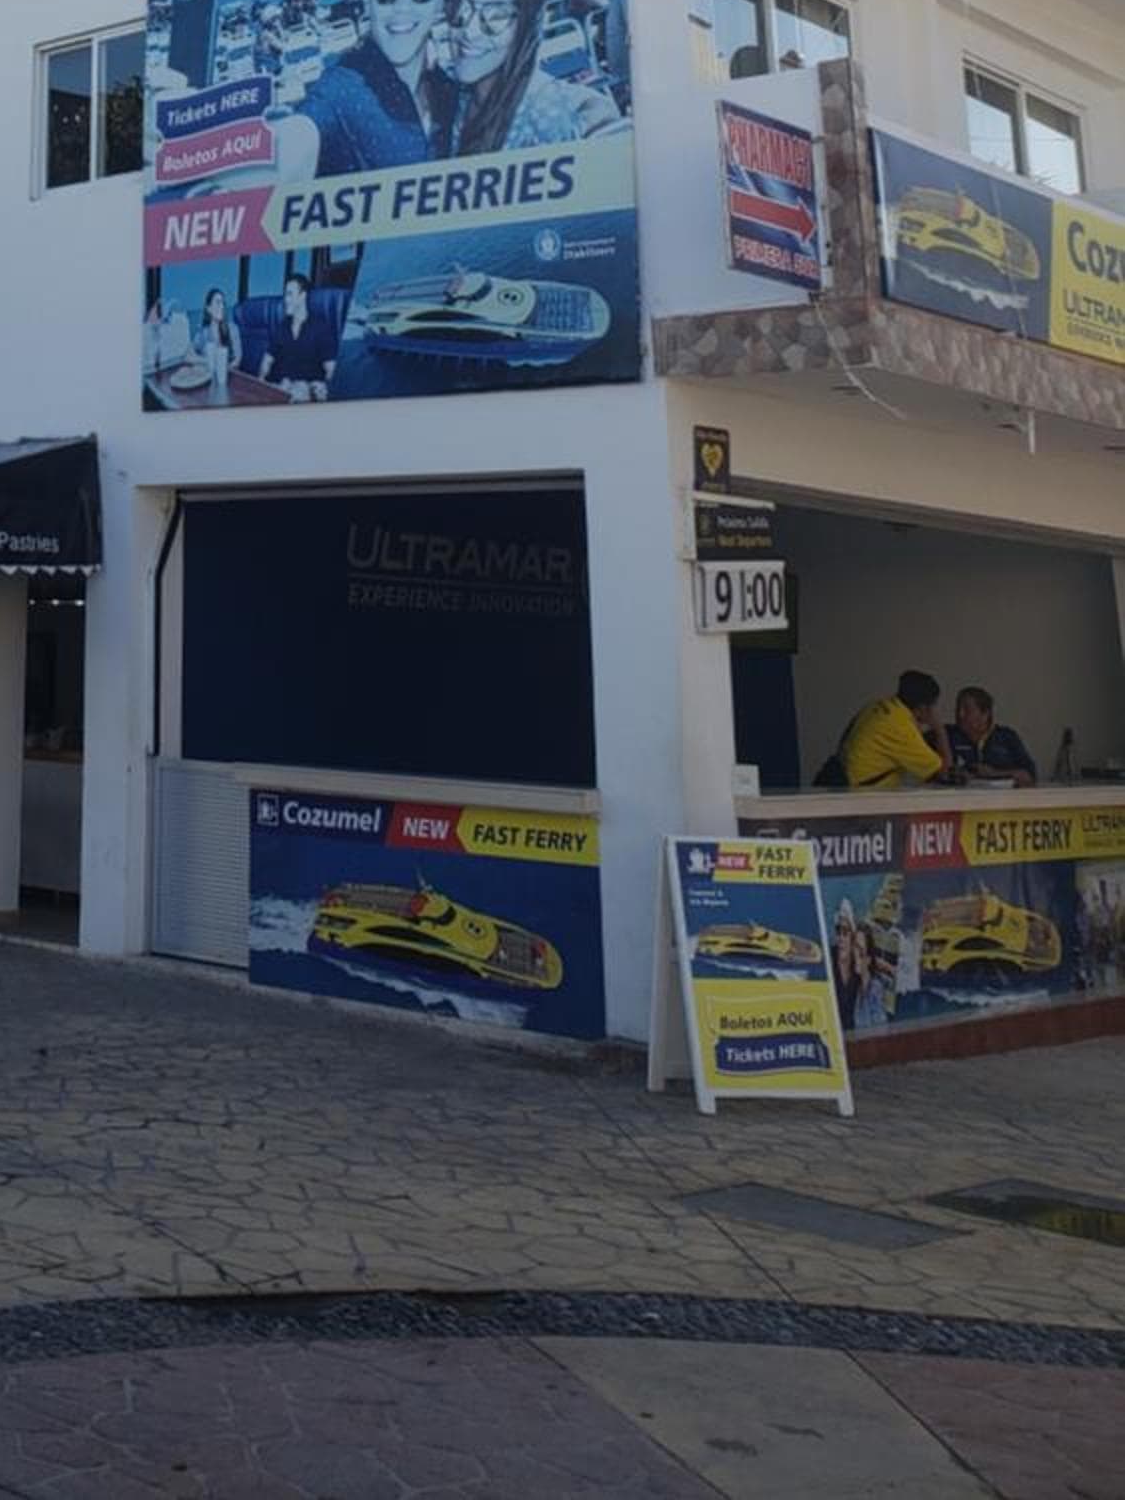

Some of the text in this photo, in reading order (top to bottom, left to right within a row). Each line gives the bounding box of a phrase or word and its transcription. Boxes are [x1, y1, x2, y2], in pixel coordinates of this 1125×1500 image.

[168, 87, 259, 127] Tickets HERE
[163, 148, 217, 172] Boletos
[164, 155, 575, 251] NEW FAST FERRIES
[347, 523, 572, 581] ULTRAMAR
[283, 801, 587, 852] Cozumel NEW FAST FERRY
[910, 821, 954, 857] NEW
[976, 820, 1018, 854] FAST
[1023, 819, 1073, 852] FERRY
[756, 847, 792, 861] FAST
[759, 866, 805, 880] FERRY
[720, 1014, 773, 1029] Boletos
[726, 1043, 816, 1063] Tickets HERE
